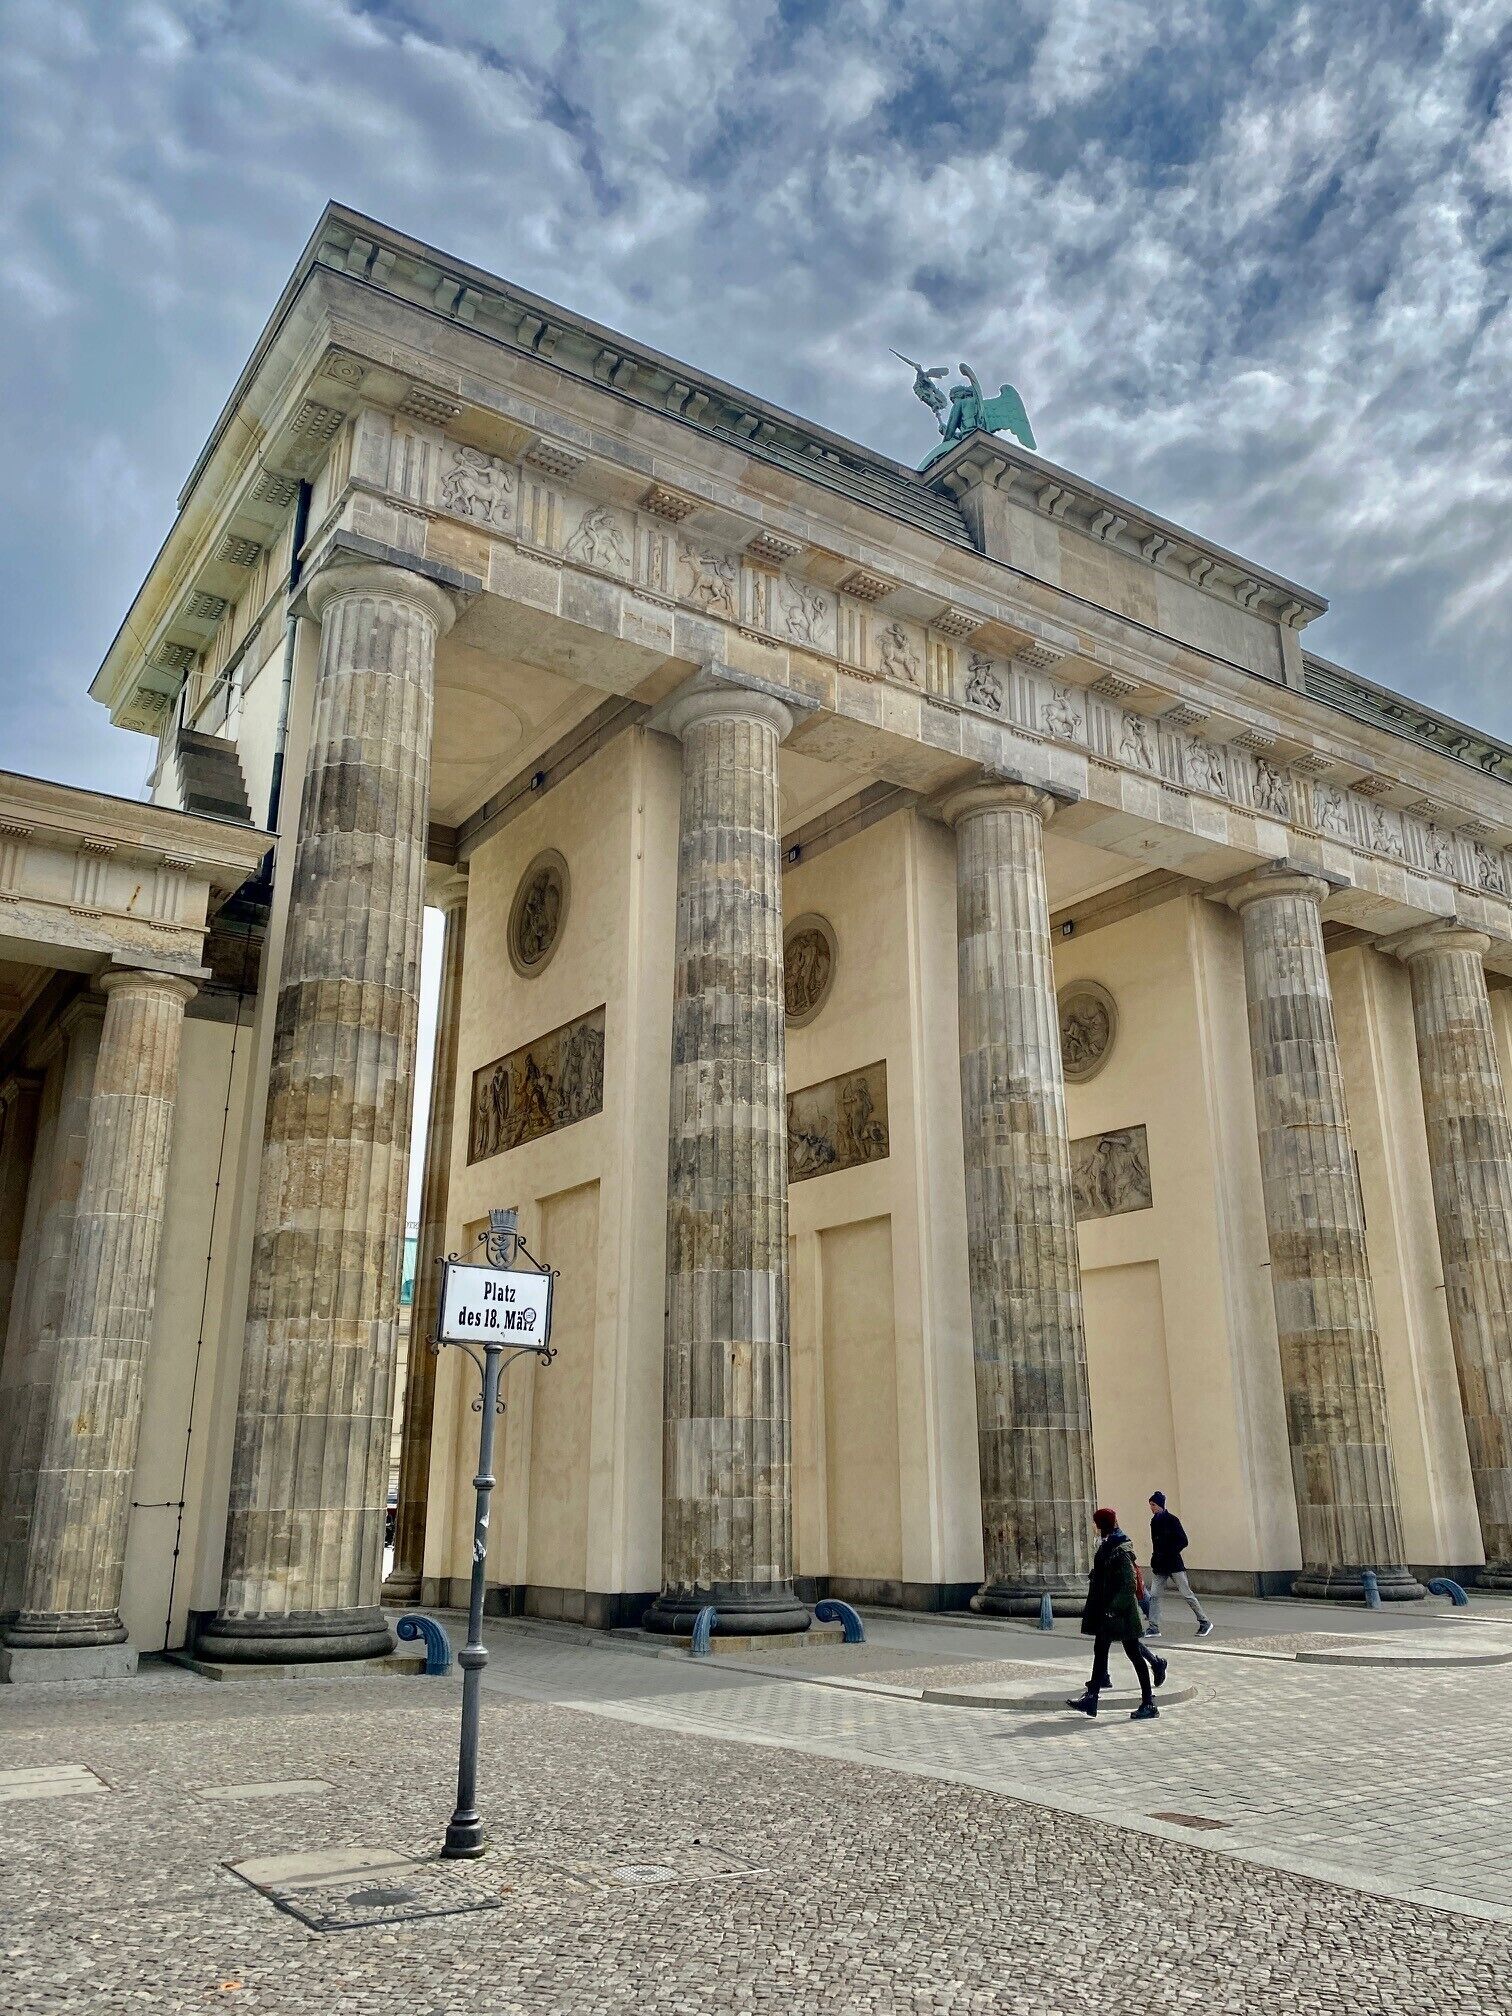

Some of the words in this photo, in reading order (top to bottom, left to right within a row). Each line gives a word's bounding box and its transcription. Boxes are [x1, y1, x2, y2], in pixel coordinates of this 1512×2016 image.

[484, 1281, 516, 1303] Platz
[458, 1306, 482, 1327] des
[484, 1308, 500, 1329] 18.
